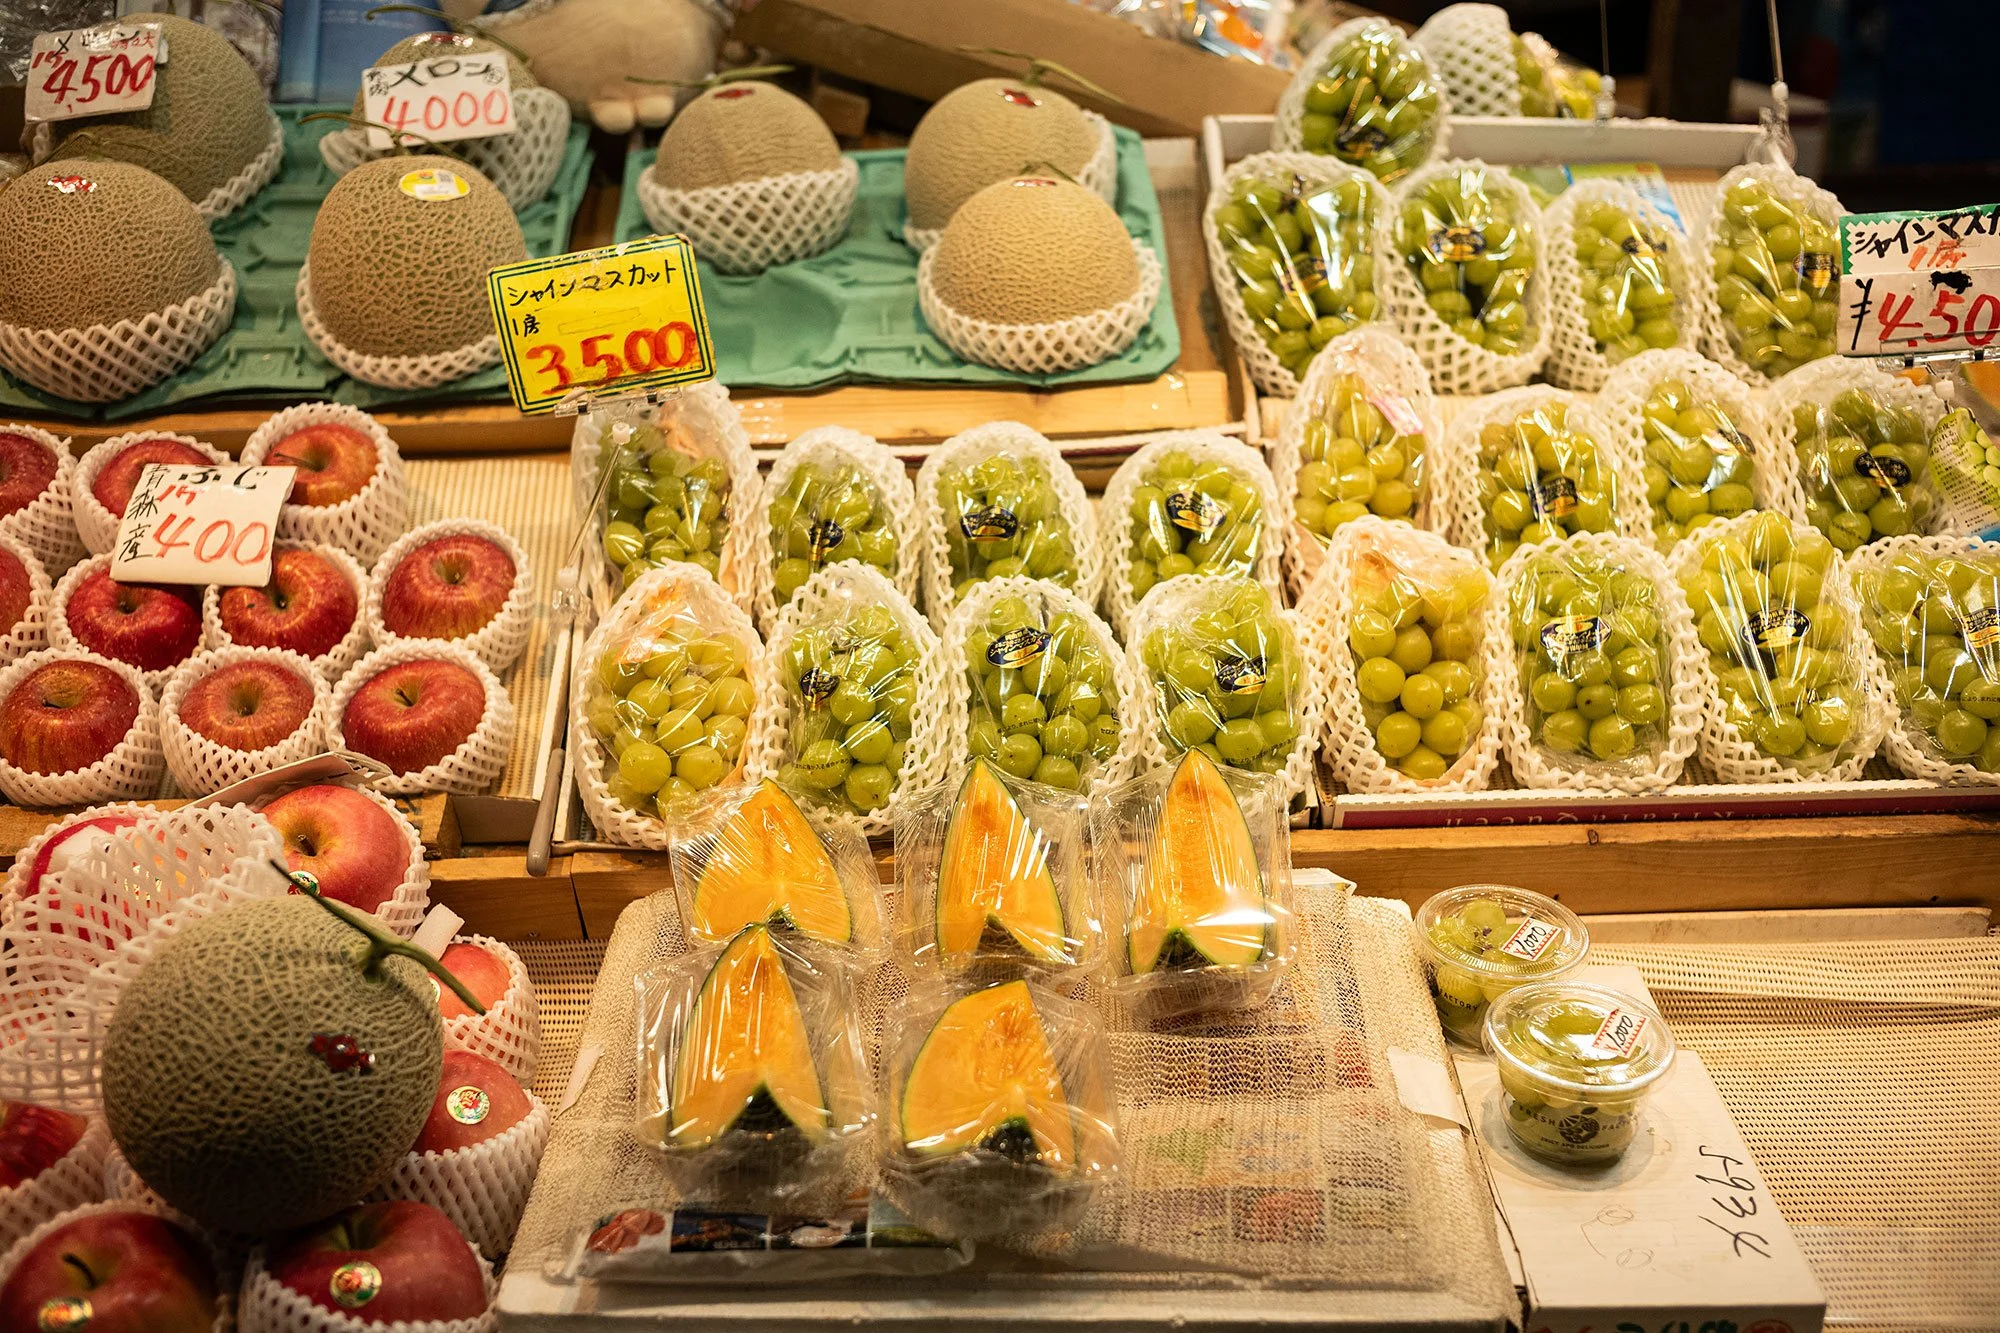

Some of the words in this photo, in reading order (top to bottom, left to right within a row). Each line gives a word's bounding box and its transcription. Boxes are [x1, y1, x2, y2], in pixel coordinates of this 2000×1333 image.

[390, 62, 492, 87] メロン
[507, 259, 677, 307] シャインマスカット
[177, 465, 268, 490] ふじ
[118, 463, 171, 563] 青森産
[152, 512, 271, 566] 400
